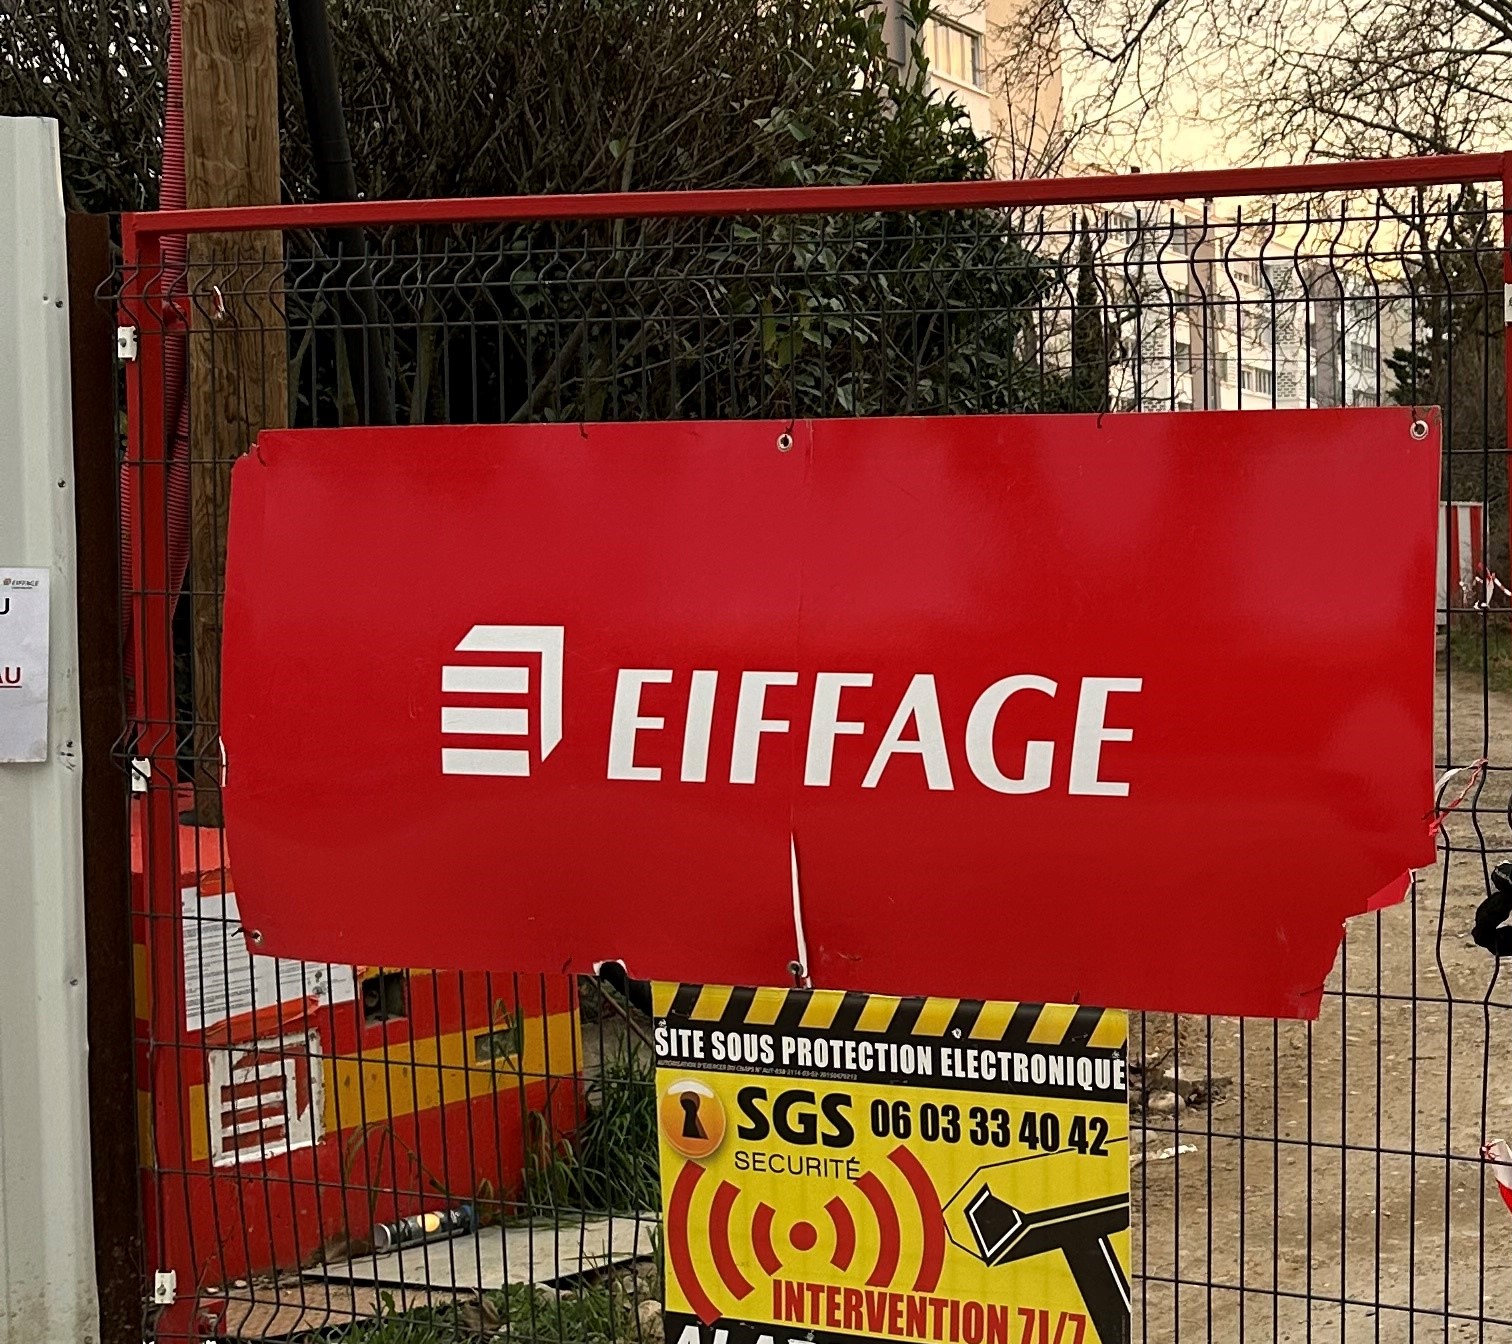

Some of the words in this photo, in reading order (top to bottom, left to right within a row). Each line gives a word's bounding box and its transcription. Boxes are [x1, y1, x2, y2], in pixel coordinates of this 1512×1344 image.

[606, 668, 1143, 797] EIFFAGE
[654, 1029, 705, 1059] SITE
[711, 1032, 775, 1064] SOUS
[781, 1036, 933, 1076] PROTECTION
[940, 1047, 1126, 1091] ELECTRONIQUE
[736, 1086, 855, 1149] SGS
[870, 1098, 913, 1141] 06
[919, 1102, 961, 1144] 03
[969, 1106, 1011, 1148] 33
[1018, 1111, 1059, 1155] 40
[1068, 1116, 1111, 1157] 42
[734, 1150, 861, 1181] SECURITÉ
